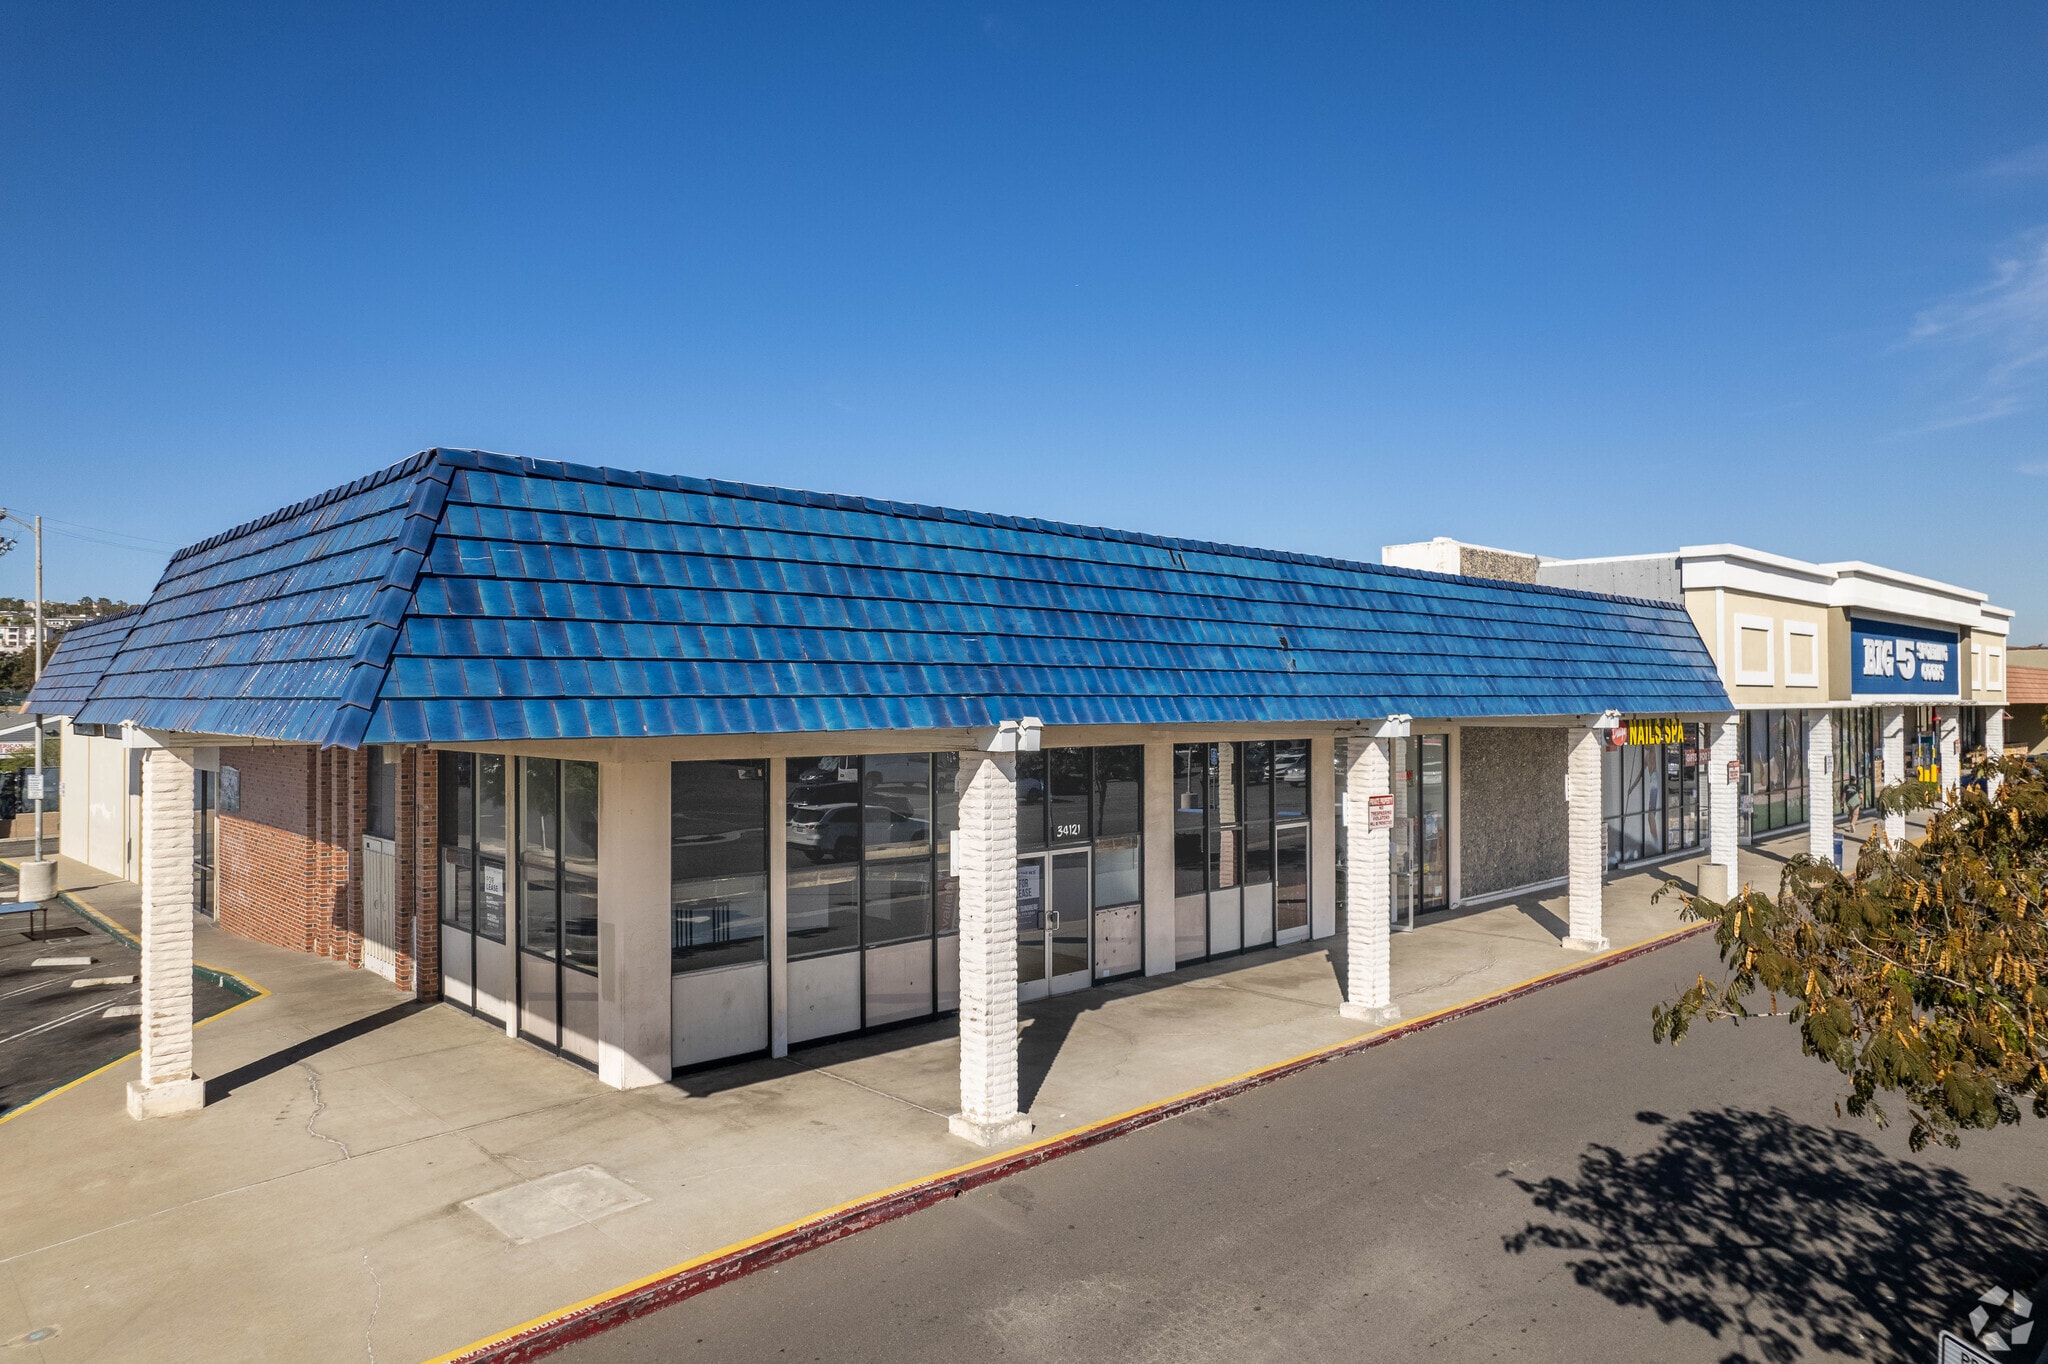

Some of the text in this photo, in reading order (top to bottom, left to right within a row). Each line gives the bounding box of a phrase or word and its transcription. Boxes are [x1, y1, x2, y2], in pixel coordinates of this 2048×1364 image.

[1863, 638, 1915, 680] BIG 5
[1629, 719, 1661, 746] NAILS
[1664, 718, 1684, 745] SPA
[1057, 824, 1081, 837] 34121
[1018, 878, 1029, 889] FOR
[1017, 887, 1032, 898] EASE
